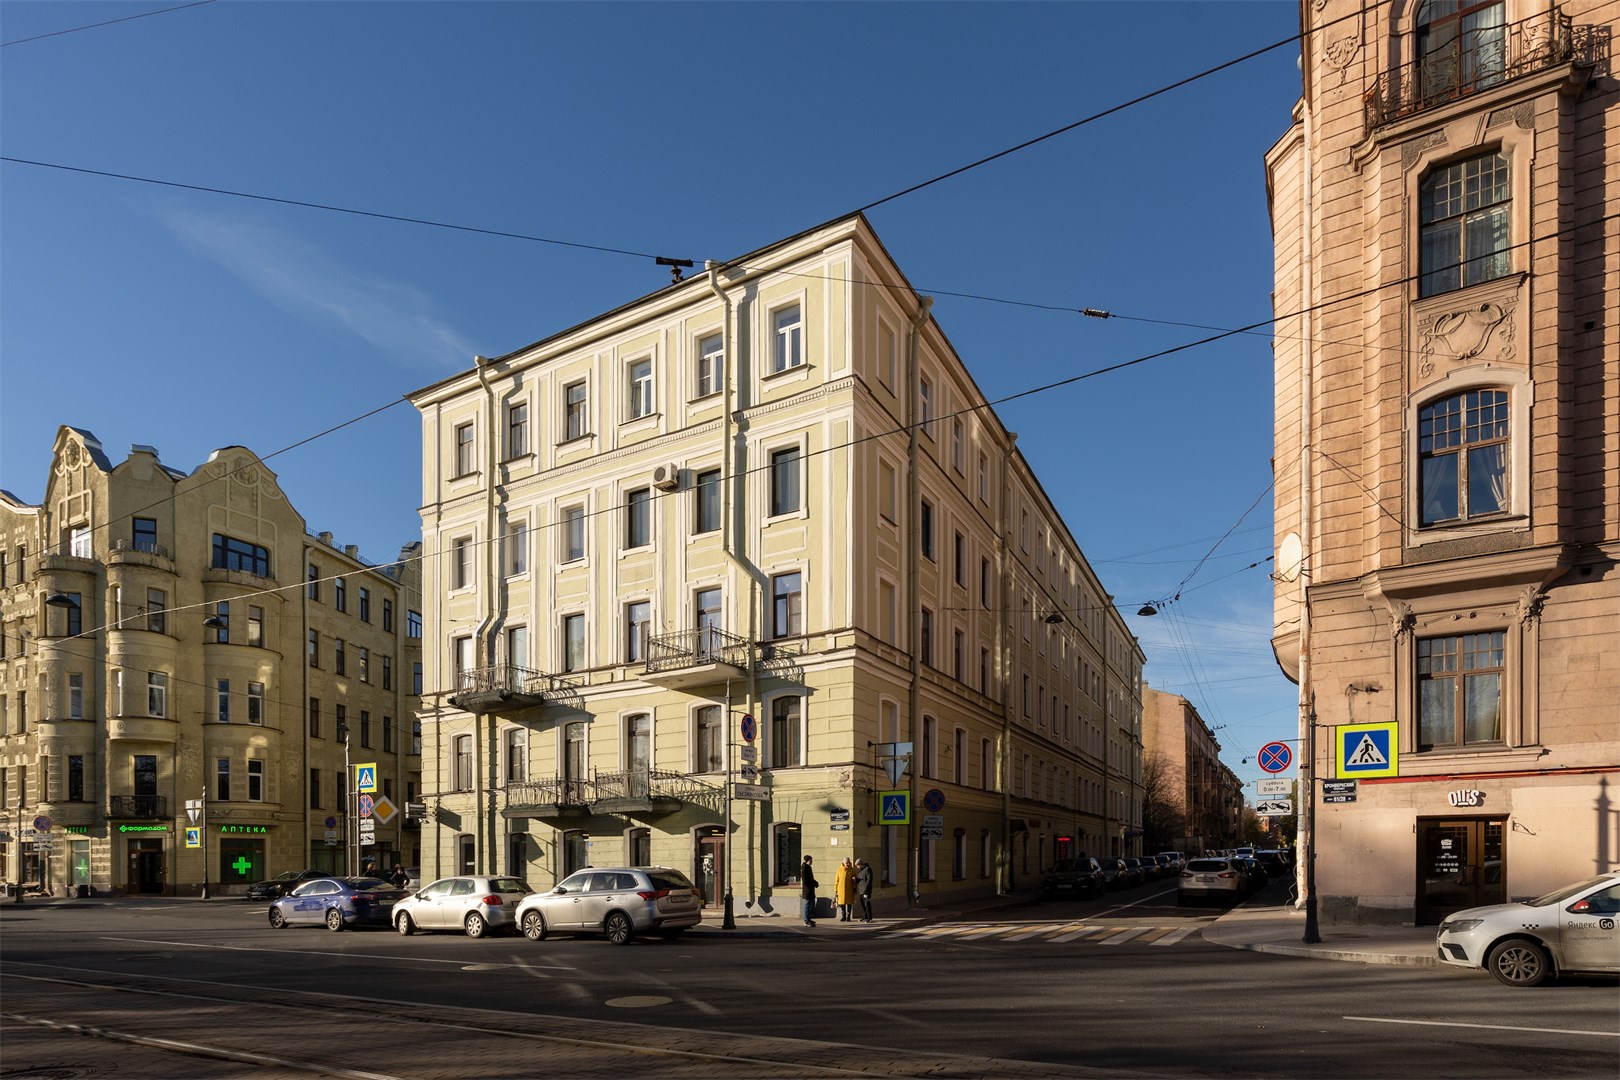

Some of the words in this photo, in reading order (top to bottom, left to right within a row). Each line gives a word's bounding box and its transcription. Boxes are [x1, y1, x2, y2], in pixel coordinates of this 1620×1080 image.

[220, 825, 267, 833] АПТЕКА
[1567, 921, 1597, 929] Яндекс
[1600, 919, 1613, 928] Go
